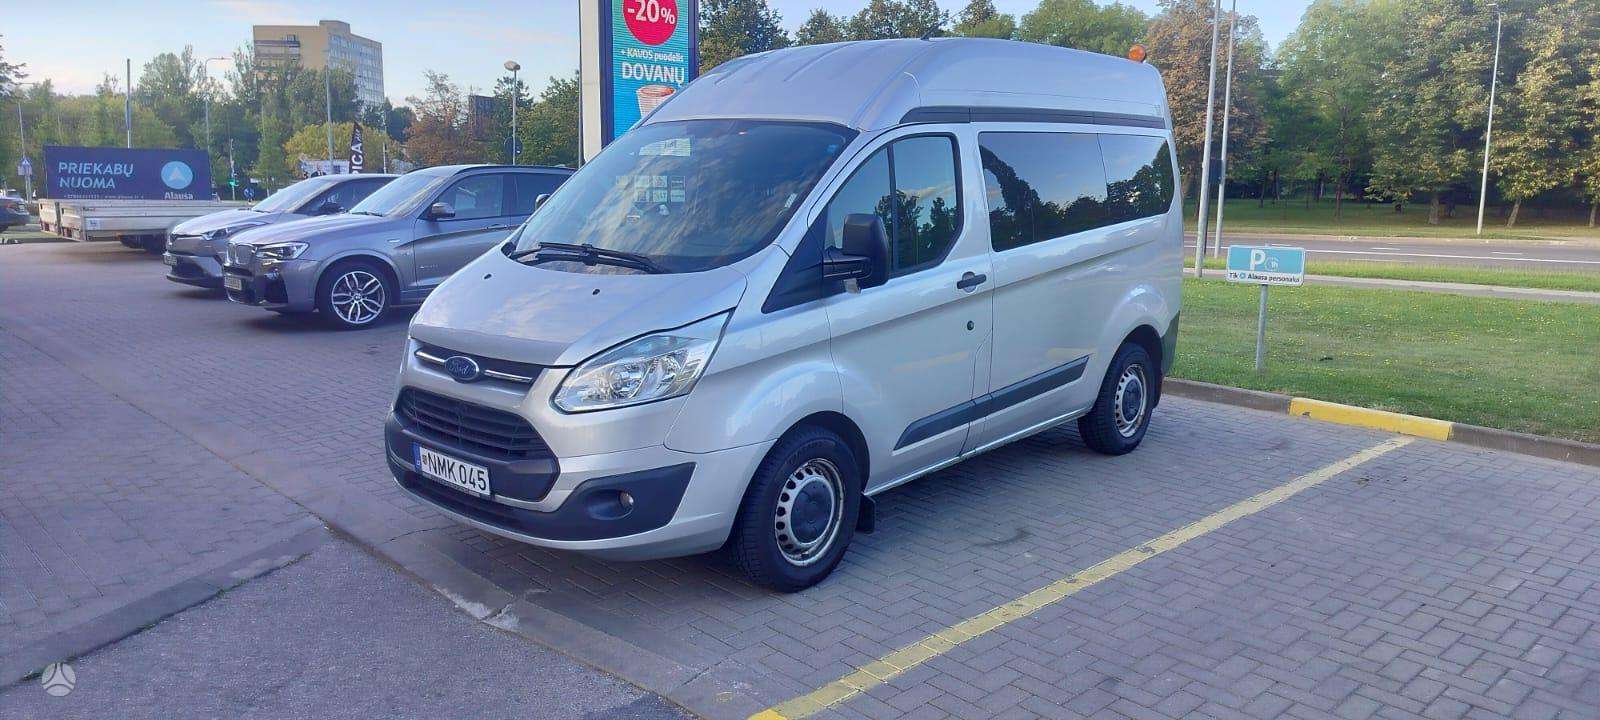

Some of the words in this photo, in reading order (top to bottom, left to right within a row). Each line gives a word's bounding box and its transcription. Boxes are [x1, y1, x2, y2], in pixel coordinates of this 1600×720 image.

[628, 0, 676, 24] -20%
[627, 47, 653, 59] KAVOS
[621, 61, 685, 87] DOVANŲ
[58, 161, 134, 178] PRIEKABŲ
[59, 177, 116, 189] NUOMA
[1249, 249, 1266, 271] P
[427, 452, 457, 483] NMK
[458, 465, 488, 492] 045
